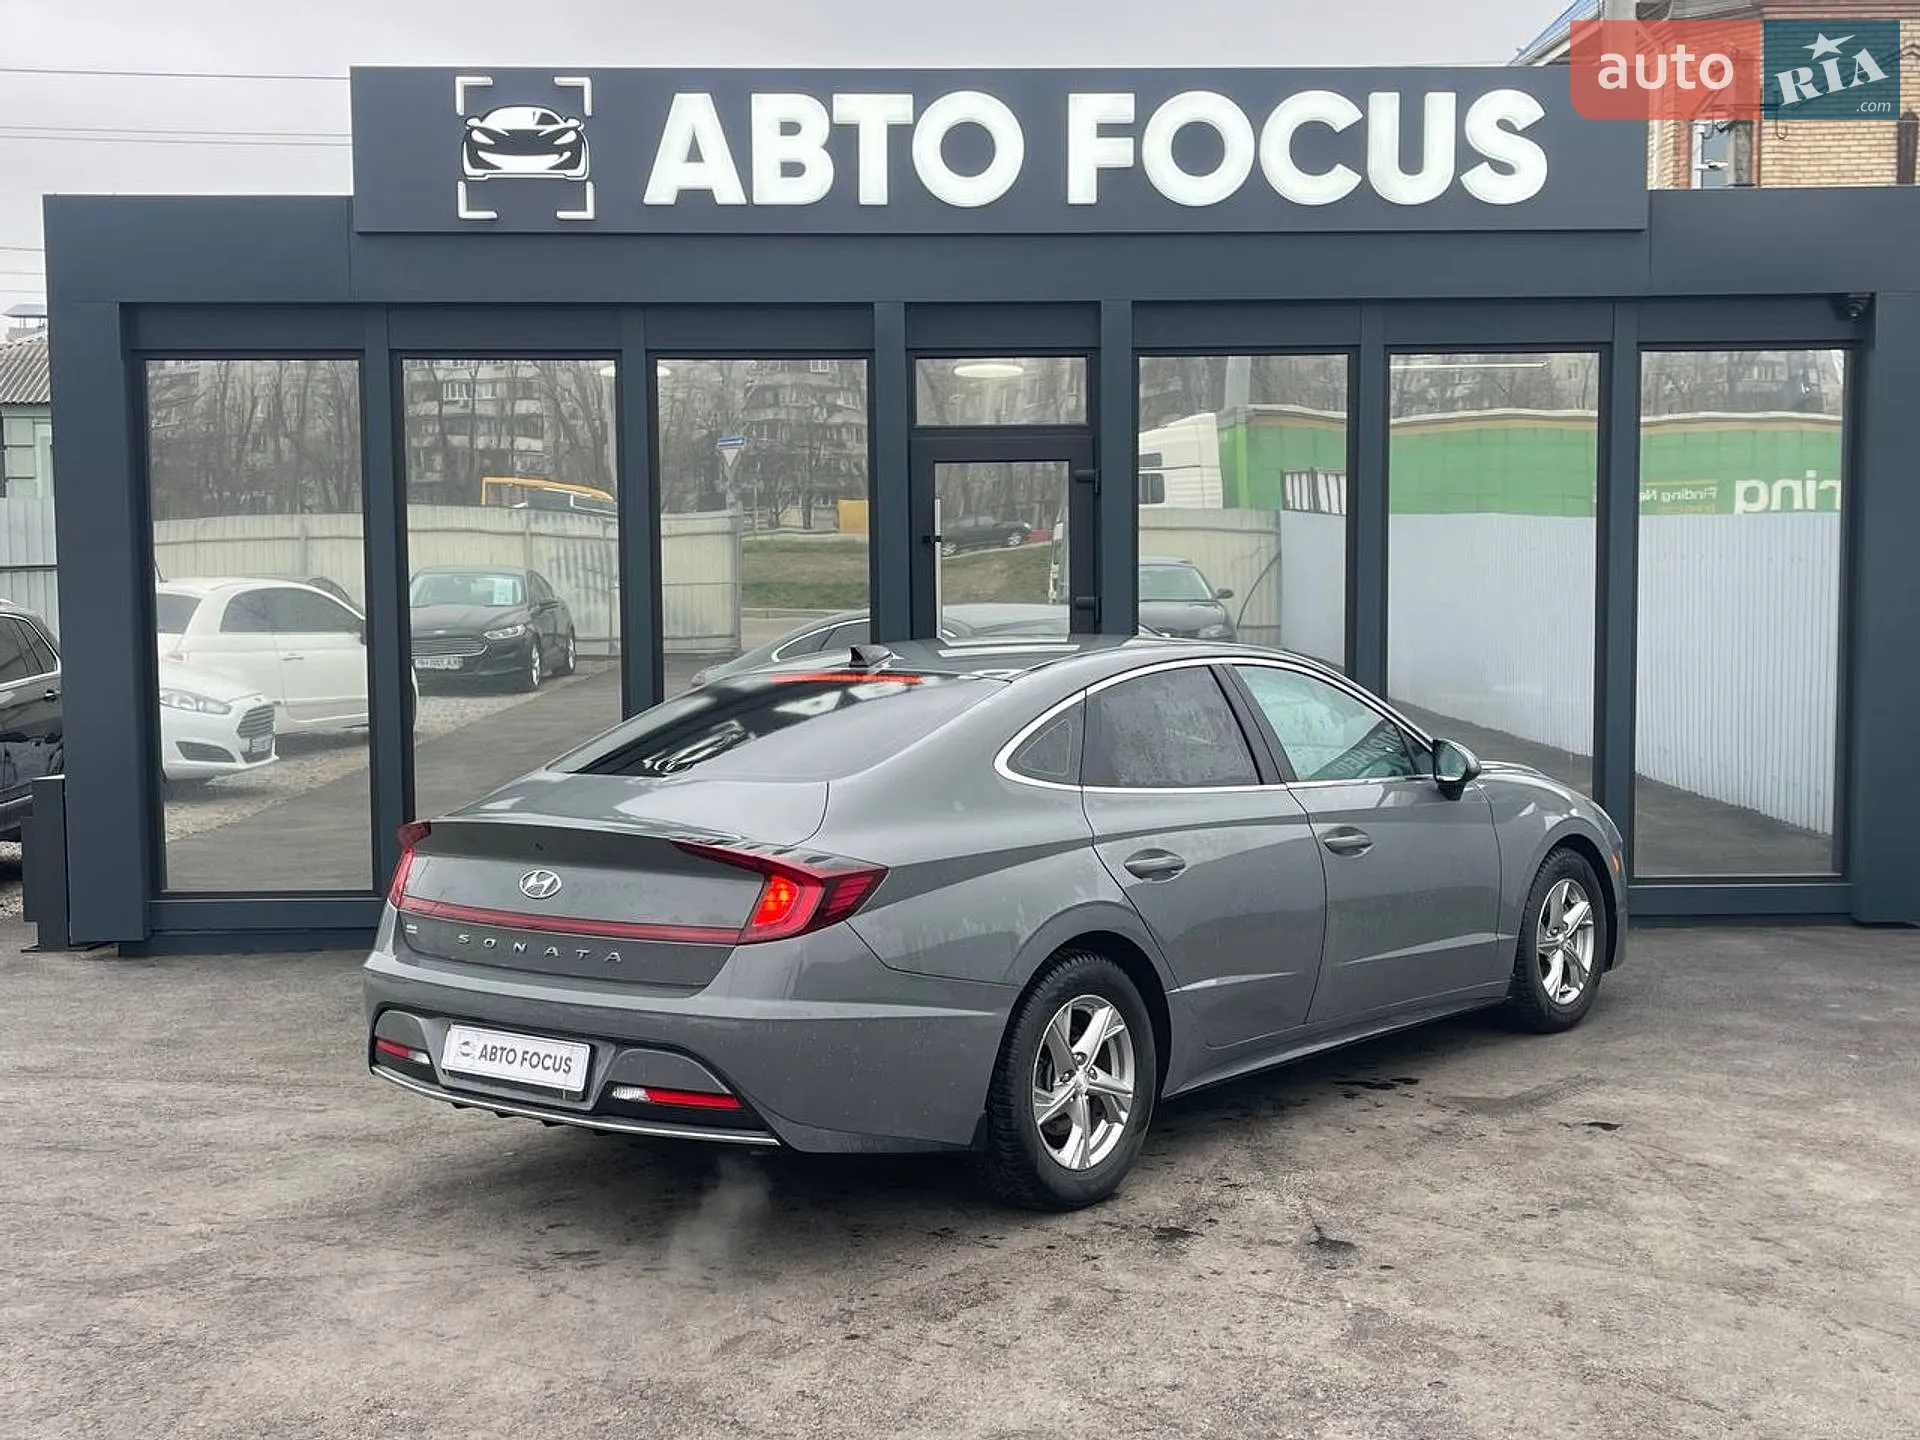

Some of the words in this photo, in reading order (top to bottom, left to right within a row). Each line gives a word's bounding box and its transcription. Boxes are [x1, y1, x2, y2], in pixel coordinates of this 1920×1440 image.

[643, 90, 1024, 207] АВТО
[1067, 89, 1548, 207] FOCUS
[458, 933, 622, 963] SONATA
[479, 1044, 517, 1065] АВТО
[520, 1051, 573, 1074] FOCUS
